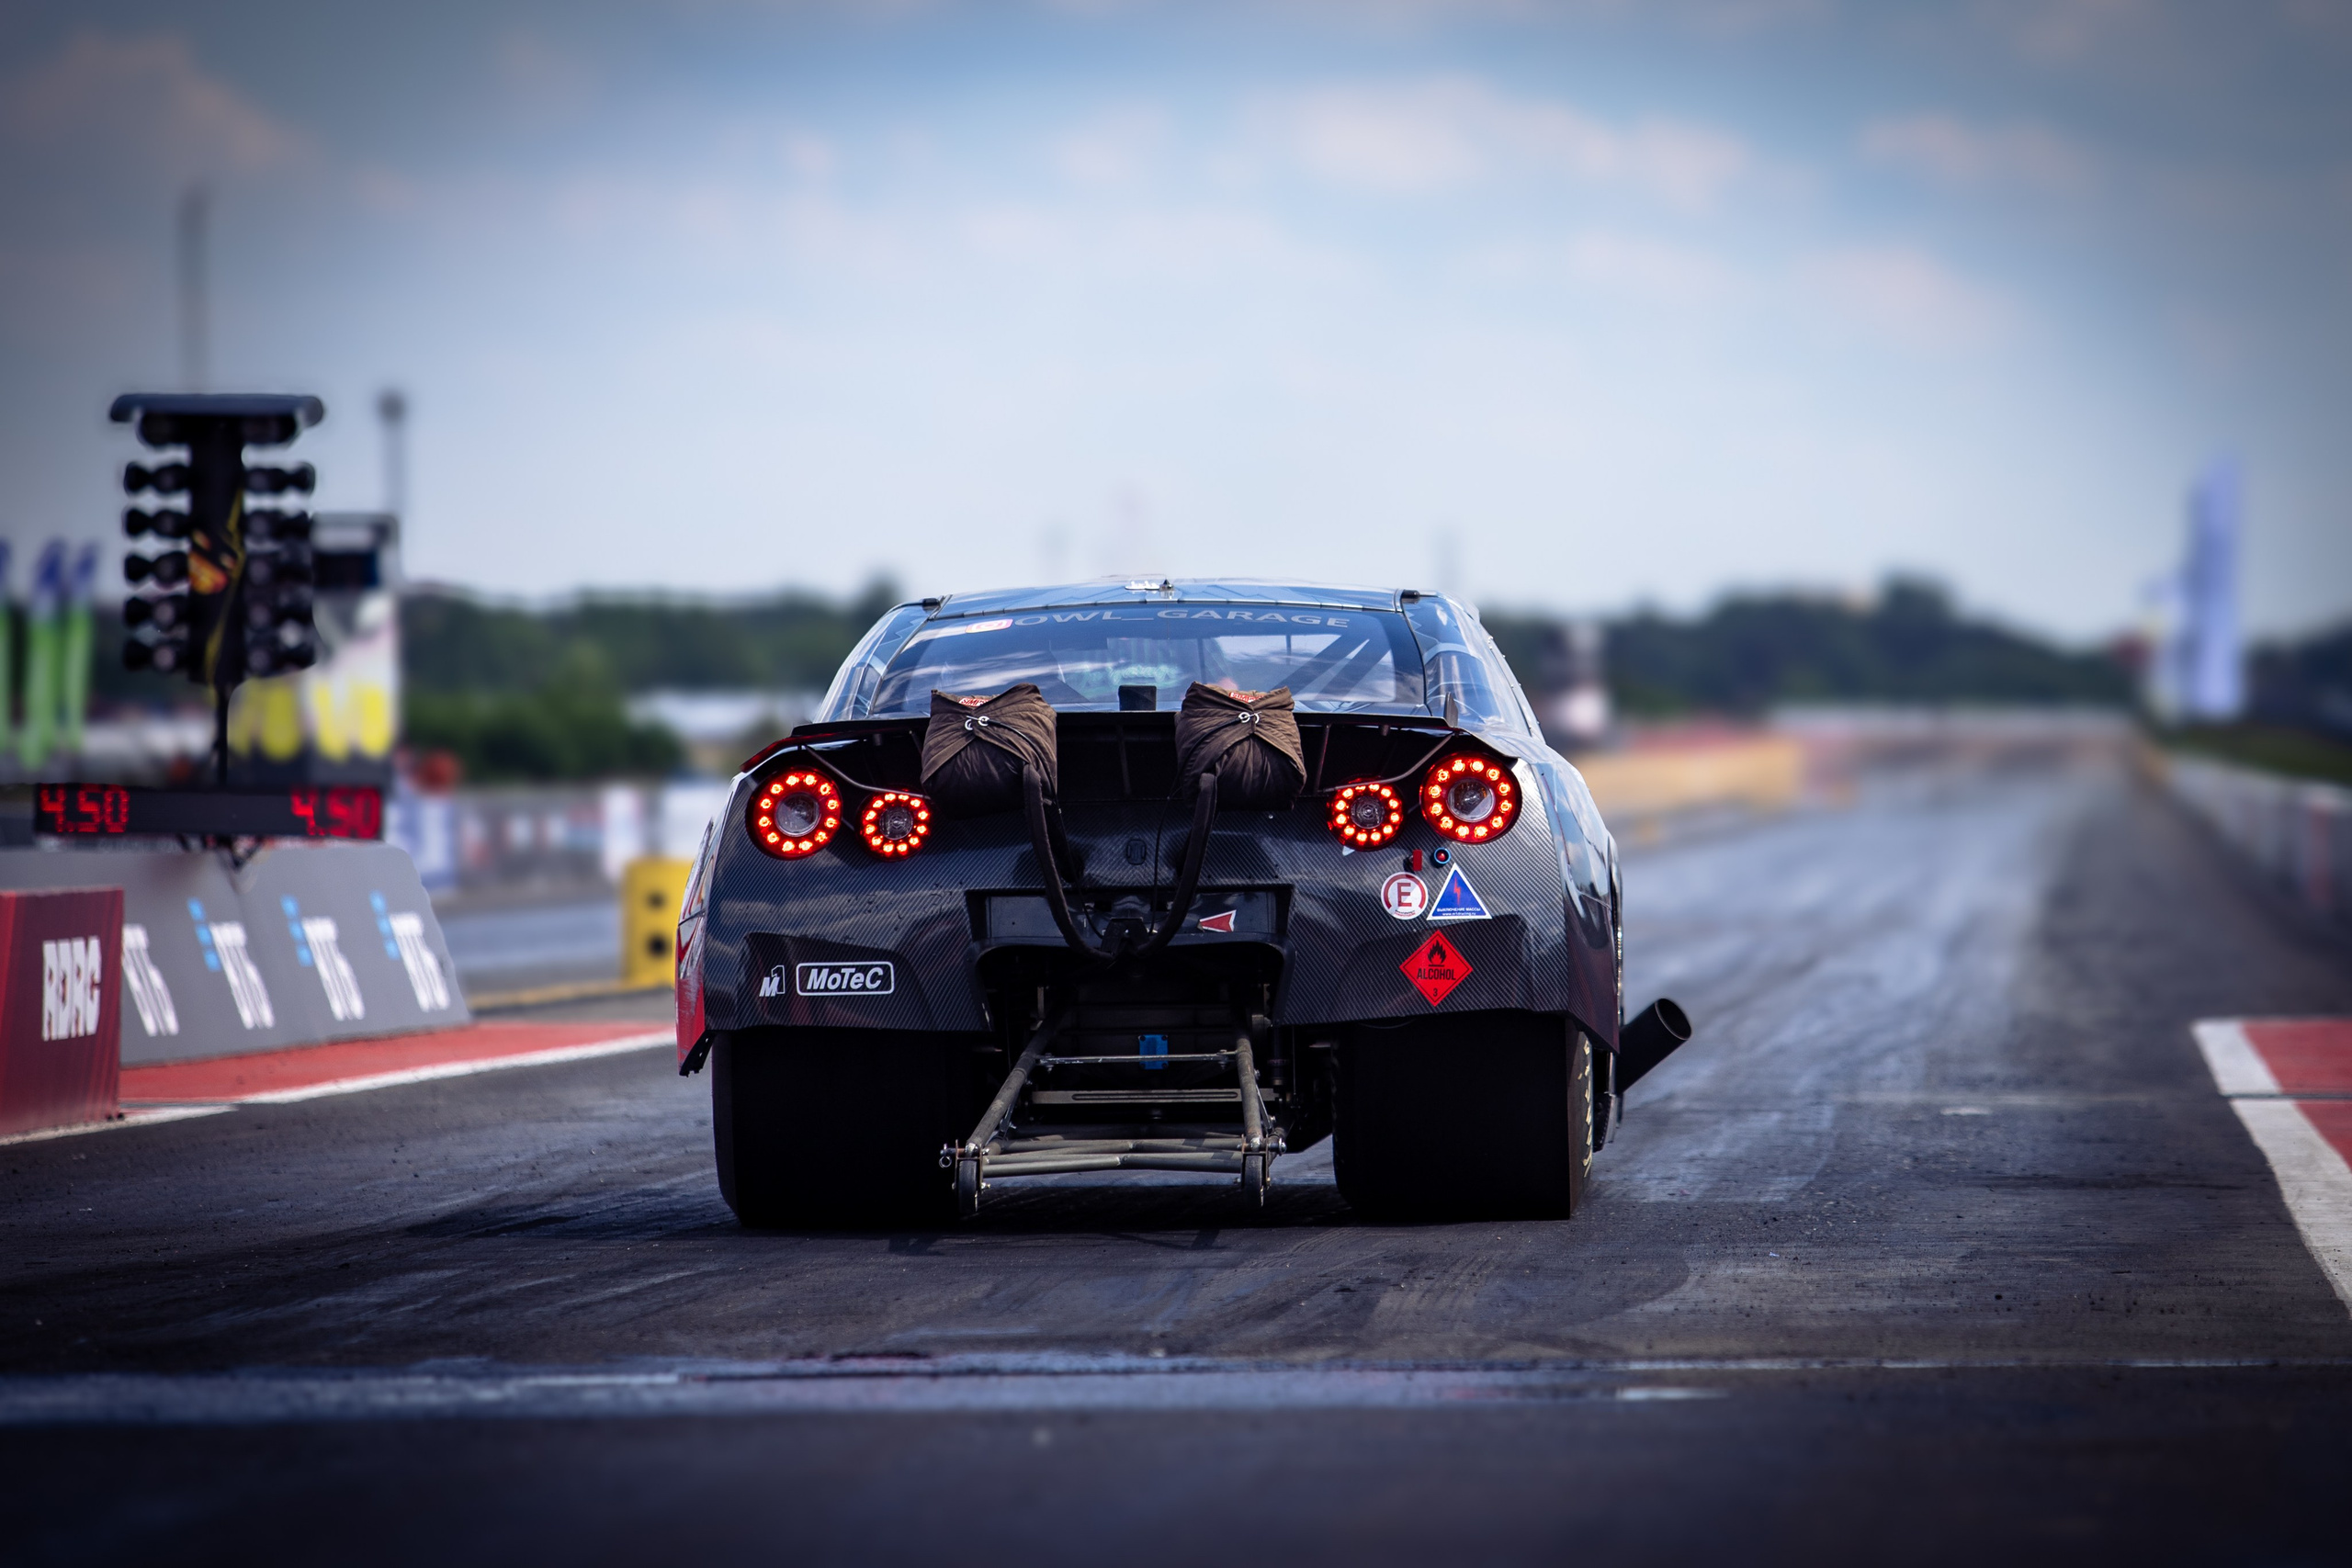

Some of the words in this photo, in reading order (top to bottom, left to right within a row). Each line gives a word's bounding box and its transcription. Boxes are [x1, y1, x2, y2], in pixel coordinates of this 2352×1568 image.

[40, 784, 130, 833] 4.50
[290, 785, 381, 839] 4.50
[1396, 882, 1413, 907] E
[806, 967, 884, 990] MoTeC
[1417, 968, 1456, 980] ALCOHOL
[42, 935, 102, 1042] RDRC
[1432, 987, 1438, 998] 3
